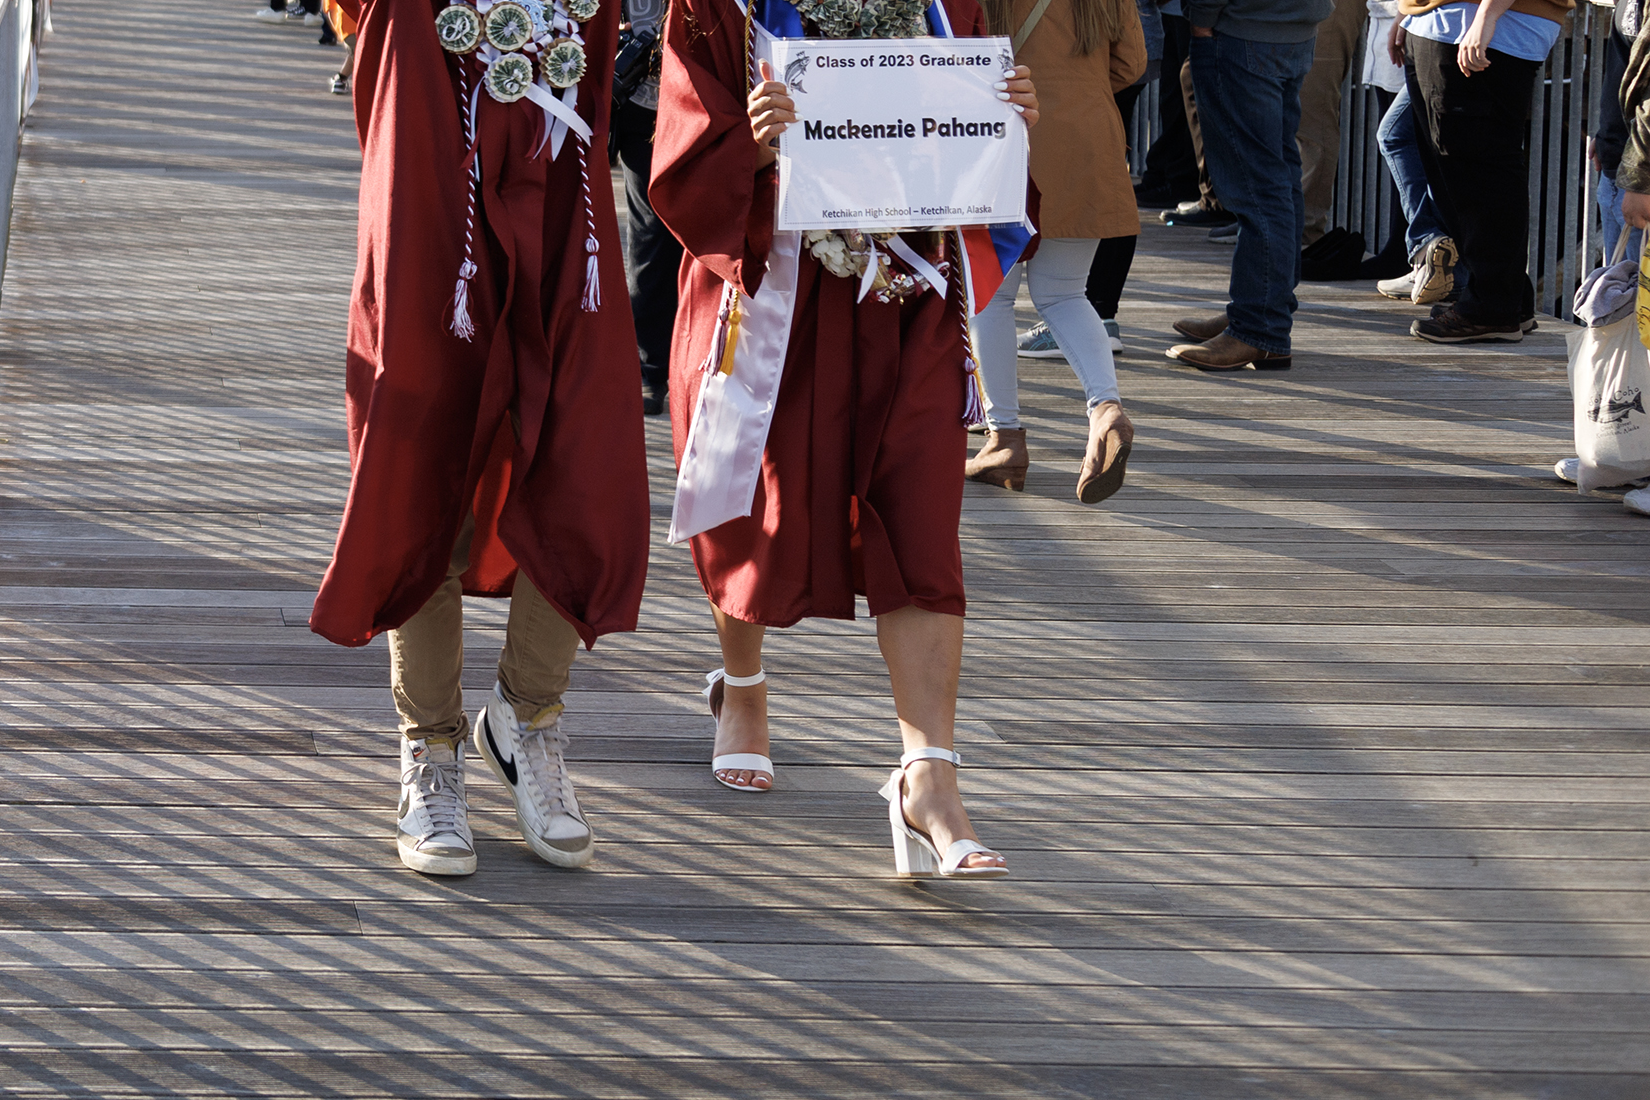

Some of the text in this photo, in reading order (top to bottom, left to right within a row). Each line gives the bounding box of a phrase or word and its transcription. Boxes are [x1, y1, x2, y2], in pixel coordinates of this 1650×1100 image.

[816, 55, 992, 69] Class of 2023 Graduate
[804, 117, 1006, 141] Mackenzie Pahang
[822, 209, 863, 219] Ketchikan
[865, 208, 884, 219] High
[885, 207, 912, 217] School
[921, 206, 965, 216] Ketchikan,
[967, 205, 993, 214] Alaska
[1614, 386, 1639, 401] Coho
